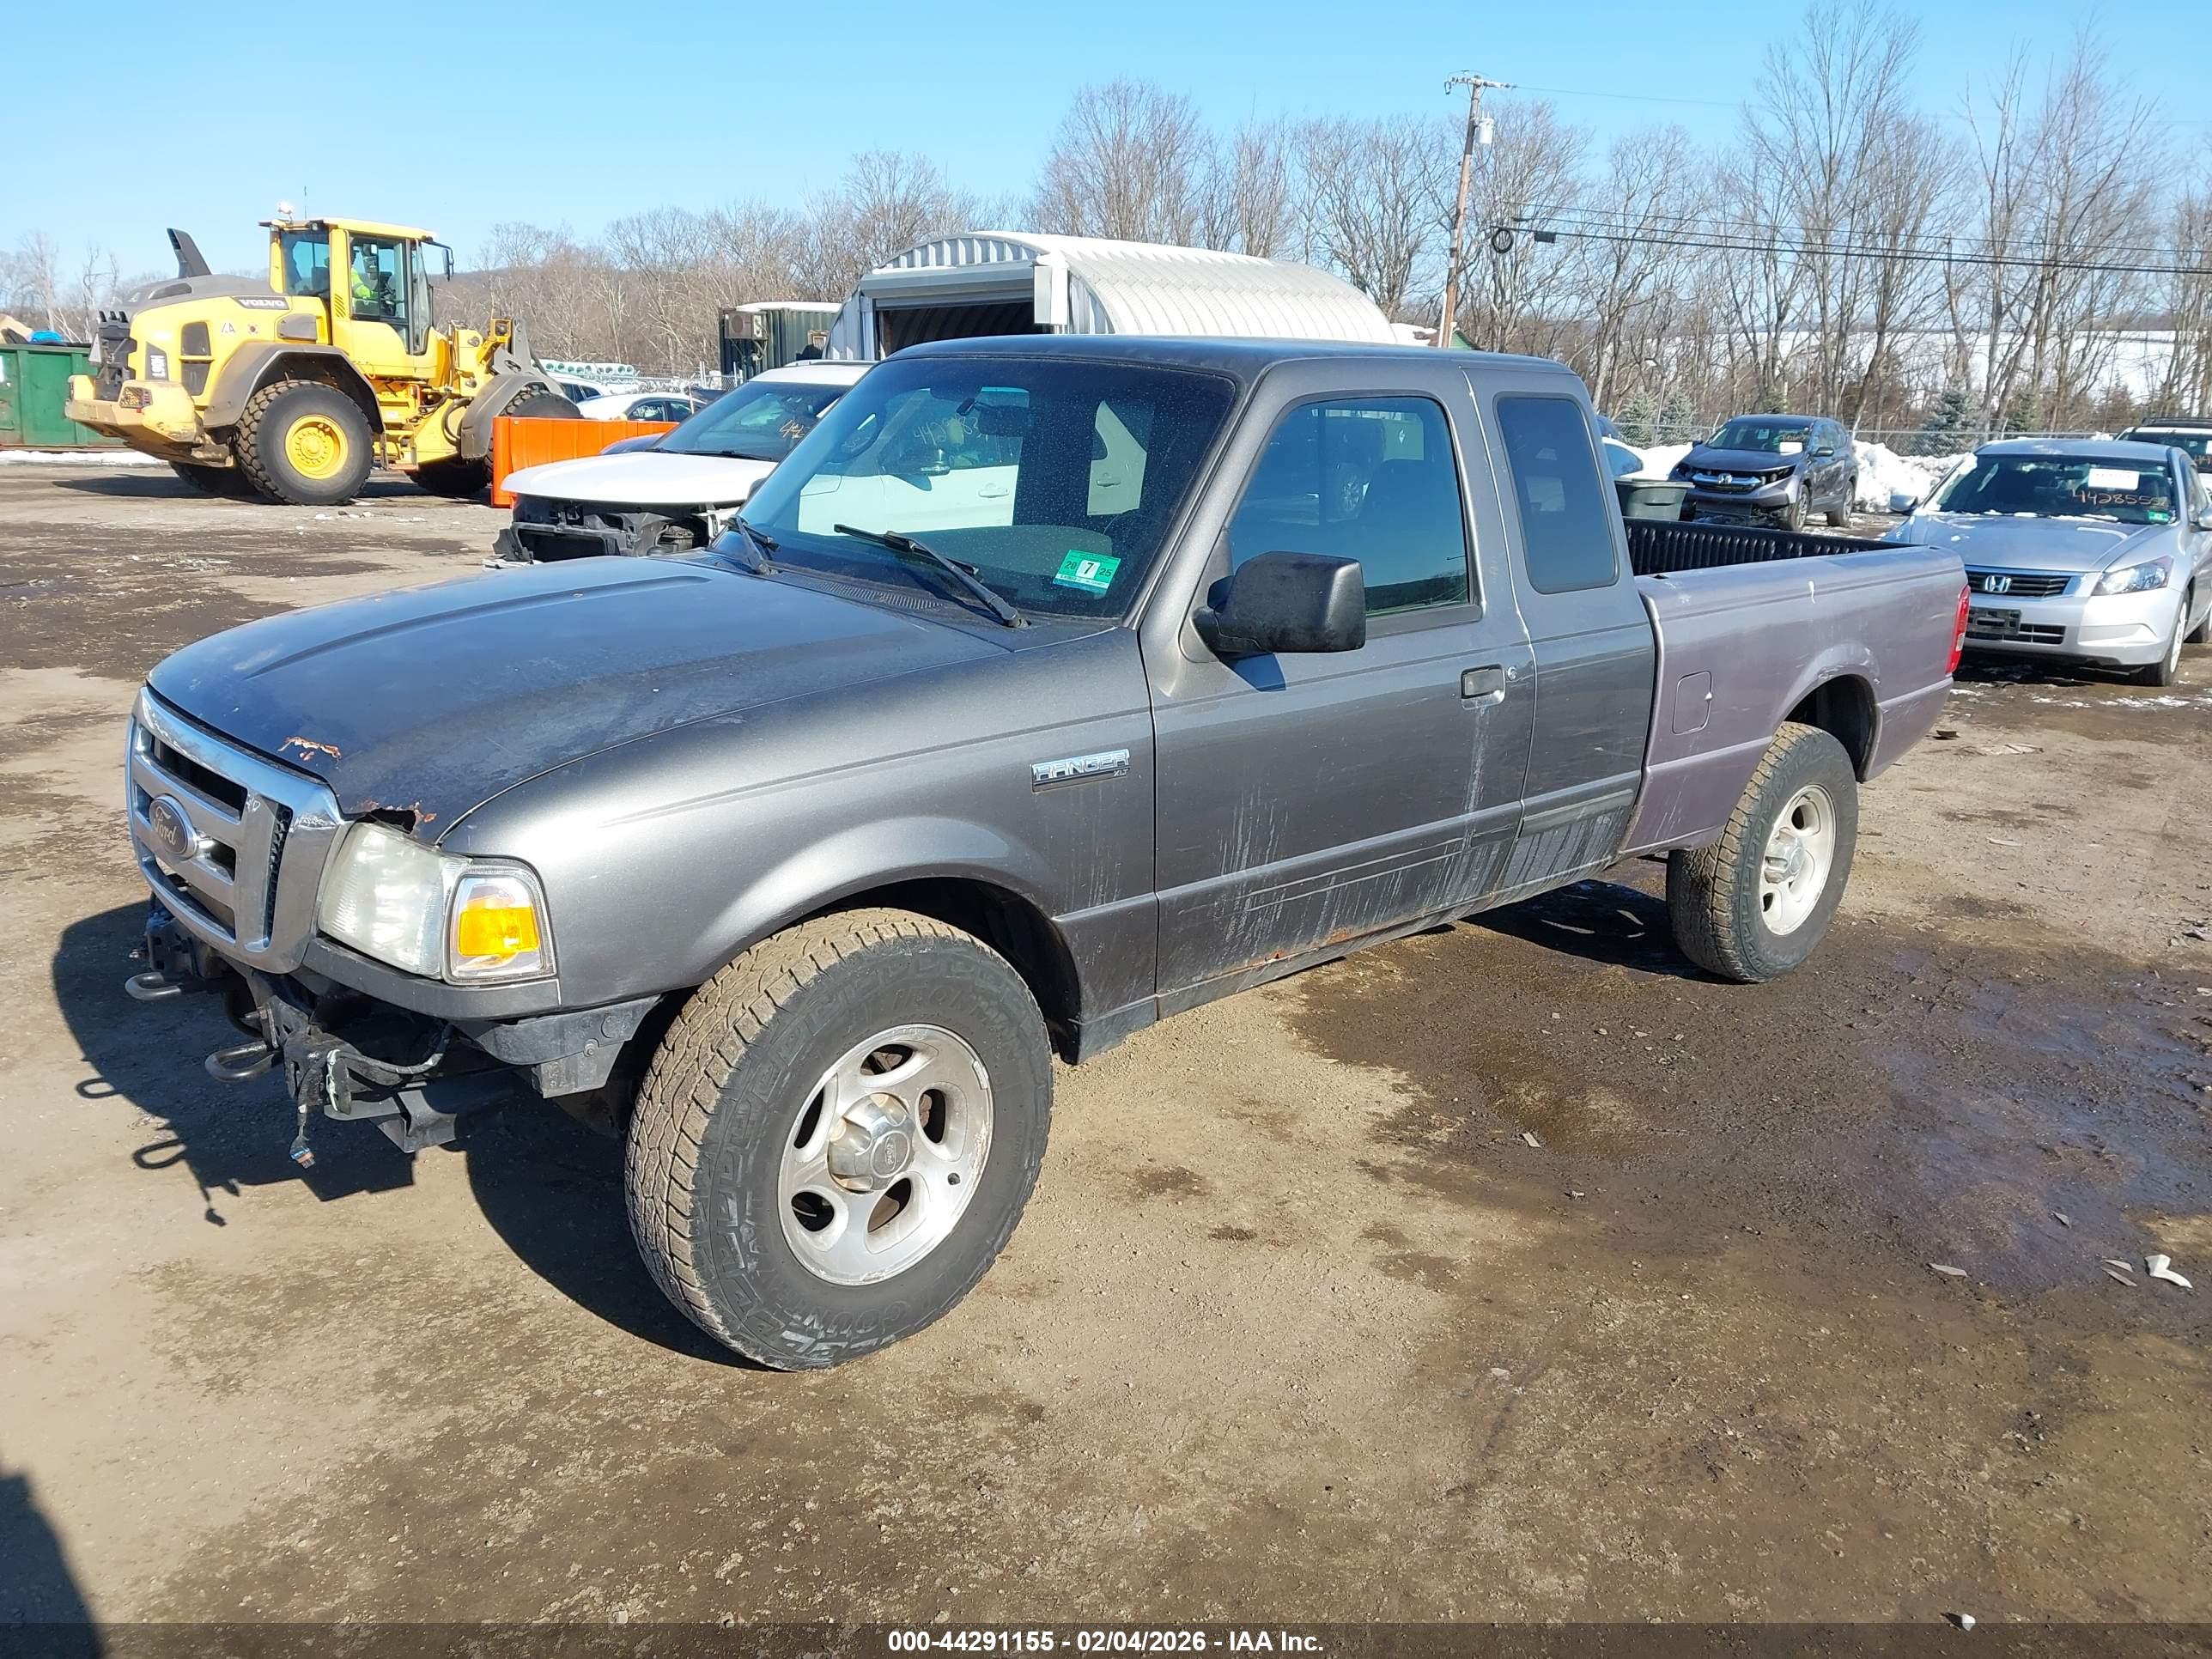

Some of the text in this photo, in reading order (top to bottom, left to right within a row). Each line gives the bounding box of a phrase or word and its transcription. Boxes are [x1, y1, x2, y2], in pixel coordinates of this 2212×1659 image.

[239, 298, 286, 307] VOLVO
[1065, 561, 1114, 577] 20 7 25
[1031, 750, 1130, 781] RANGER
[1113, 768, 1129, 777] XLT
[155, 805, 178, 846] Ford
